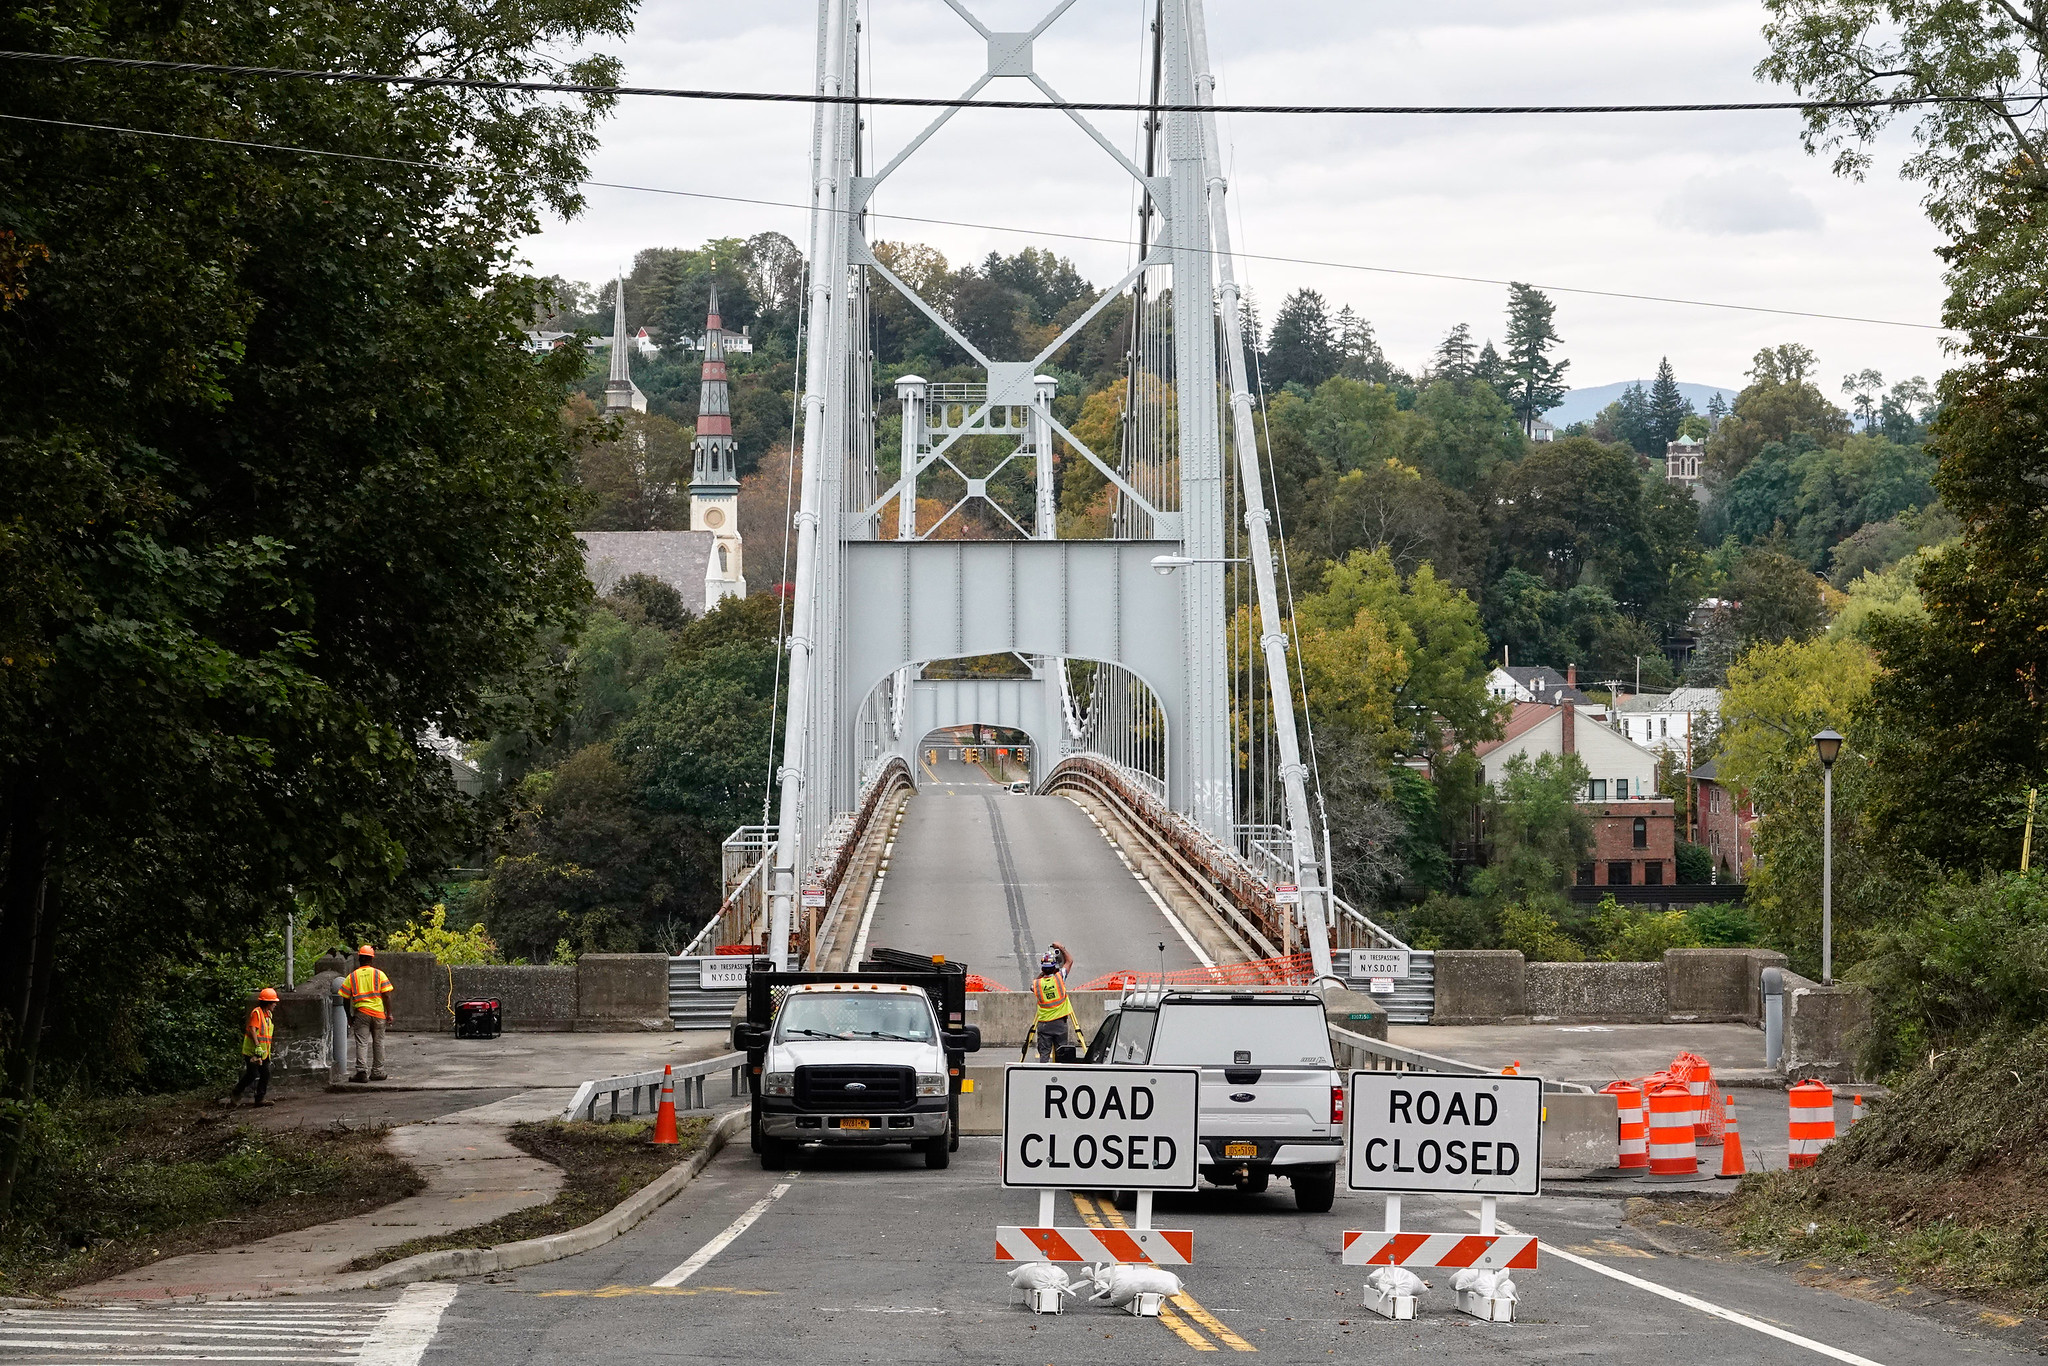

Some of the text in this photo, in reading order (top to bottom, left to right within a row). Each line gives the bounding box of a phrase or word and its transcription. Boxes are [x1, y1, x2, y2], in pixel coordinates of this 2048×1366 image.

[1360, 964, 1399, 972] N.Y.S.D.O.T.
[1045, 1085, 1154, 1120] ROAD
[1389, 1090, 1498, 1126] ROAD
[1020, 1134, 1177, 1169] CLOSED
[1365, 1138, 1520, 1176] CLOSED
